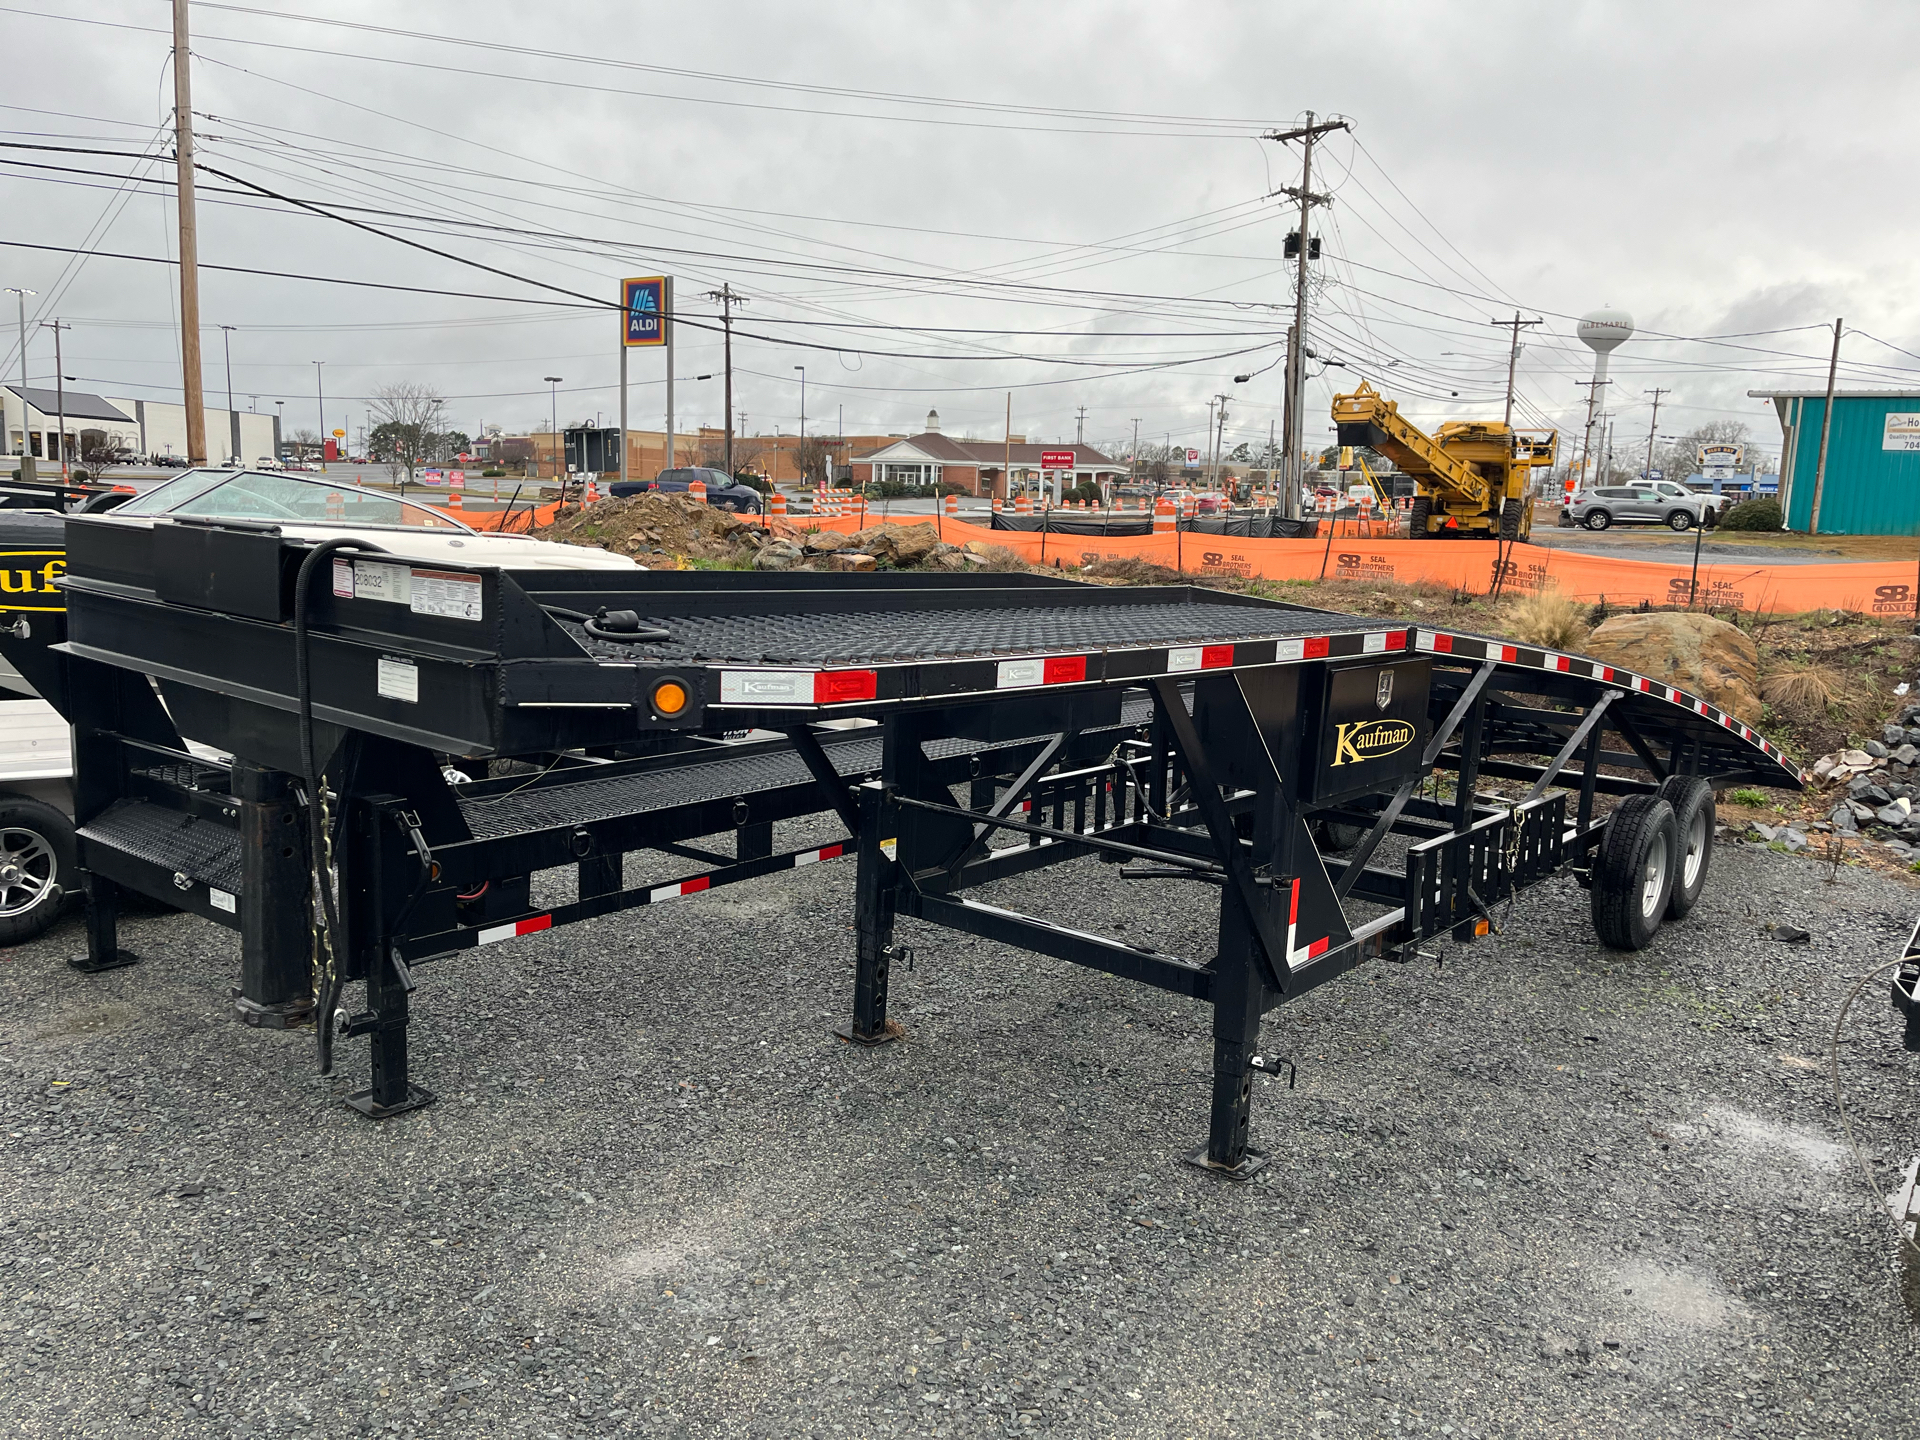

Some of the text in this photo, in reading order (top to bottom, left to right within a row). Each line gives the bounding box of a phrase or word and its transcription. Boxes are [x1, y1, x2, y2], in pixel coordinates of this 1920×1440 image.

[630, 319, 658, 331] ALDI
[1582, 321, 1628, 330] ALBEMARLE
[1907, 417, 1920, 427] Ho
[1904, 441, 1920, 449] 704
[1202, 552, 1223, 566] SB
[1222, 560, 1252, 570] BROTHERS
[1337, 554, 1361, 569] SB
[1370, 555, 1386, 563] SEAL
[1360, 563, 1395, 571] BROTHERS
[1528, 564, 1546, 572] SEAL
[354, 572, 383, 588] 208032
[1518, 570, 1557, 583] BROTHERS
[1668, 578, 1700, 595] SB
[1712, 581, 1733, 589] SEAL
[1699, 588, 1744, 600] BROTHERS
[1873, 584, 1910, 603] SB
[1667, 594, 1743, 608] CONRACTING
[743, 681, 791, 693] Kaufman
[1330, 721, 1408, 767] Kaufman
